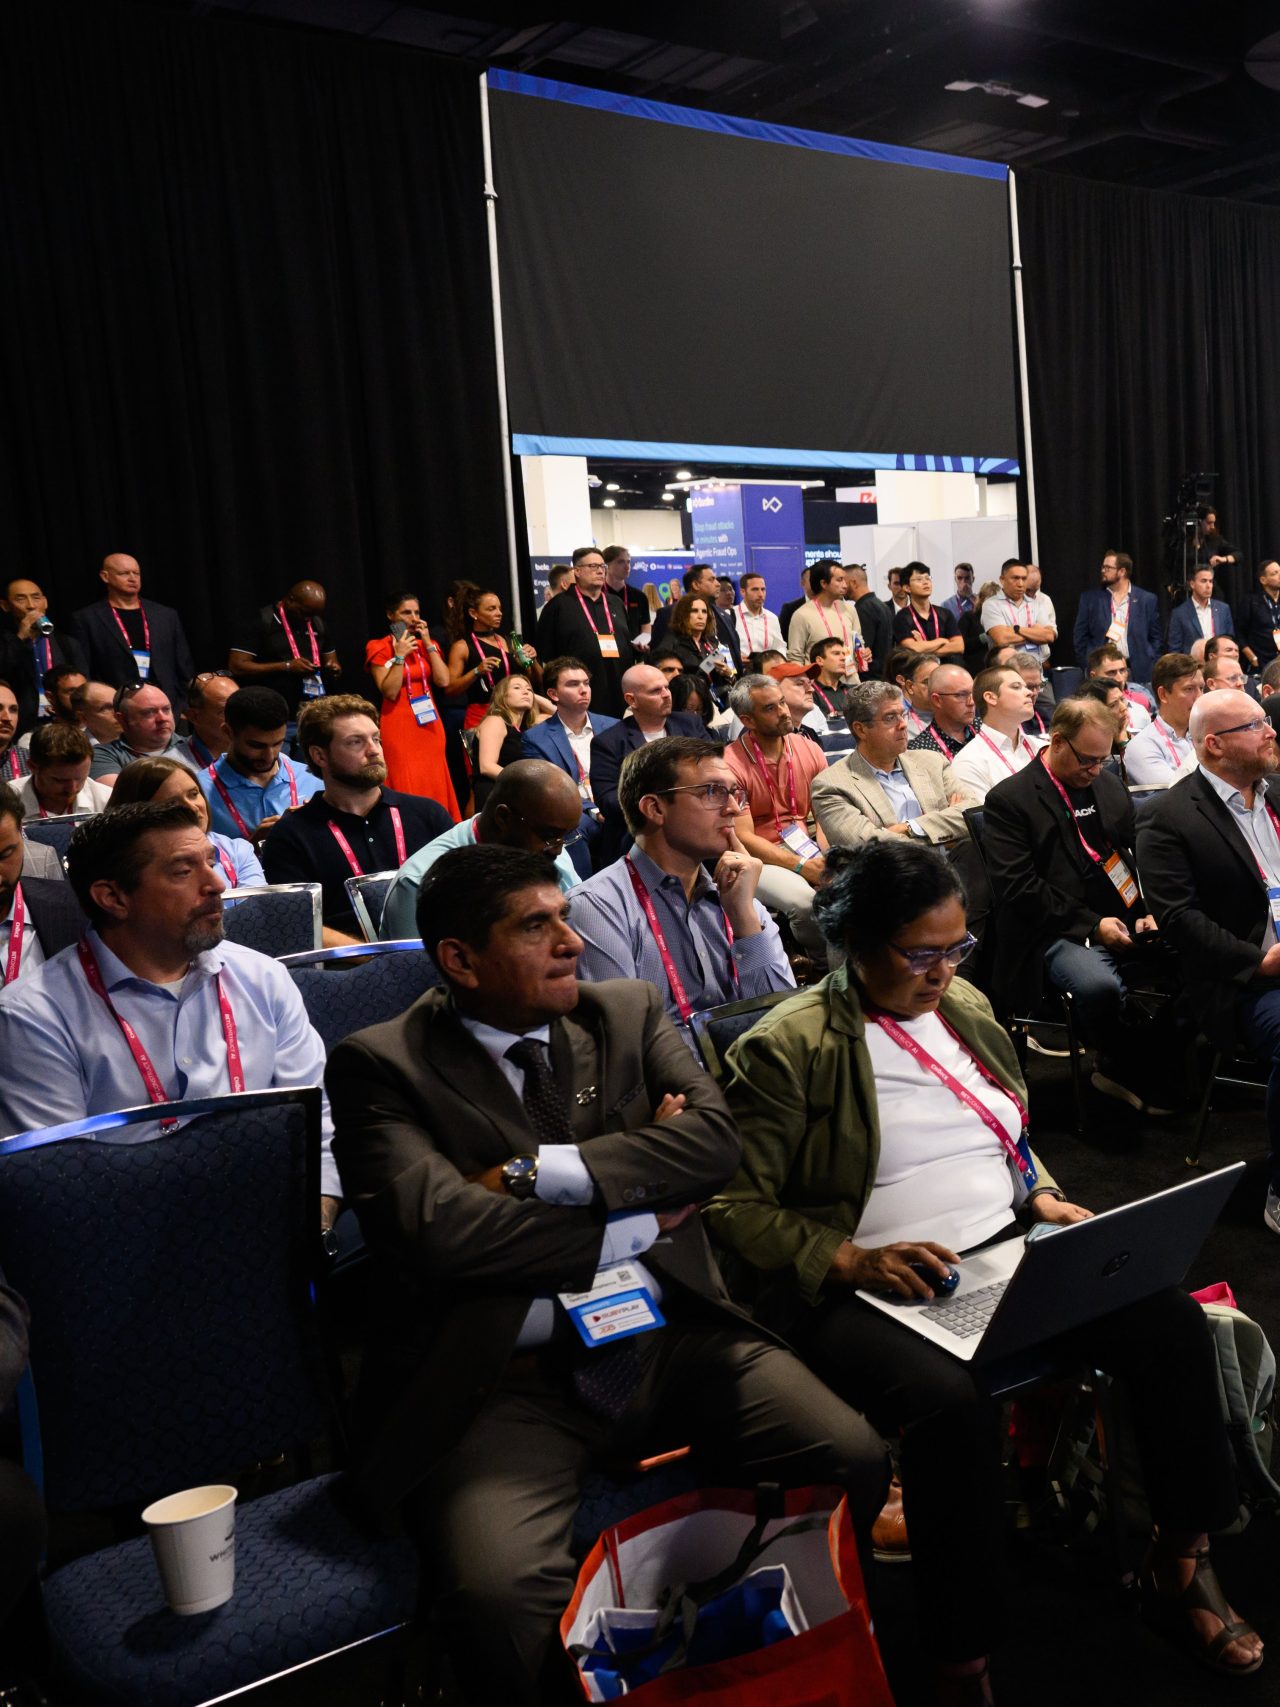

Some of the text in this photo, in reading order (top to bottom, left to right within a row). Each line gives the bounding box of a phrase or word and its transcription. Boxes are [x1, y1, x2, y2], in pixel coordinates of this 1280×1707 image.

[696, 546, 737, 559] Agentic Fraud Ops
